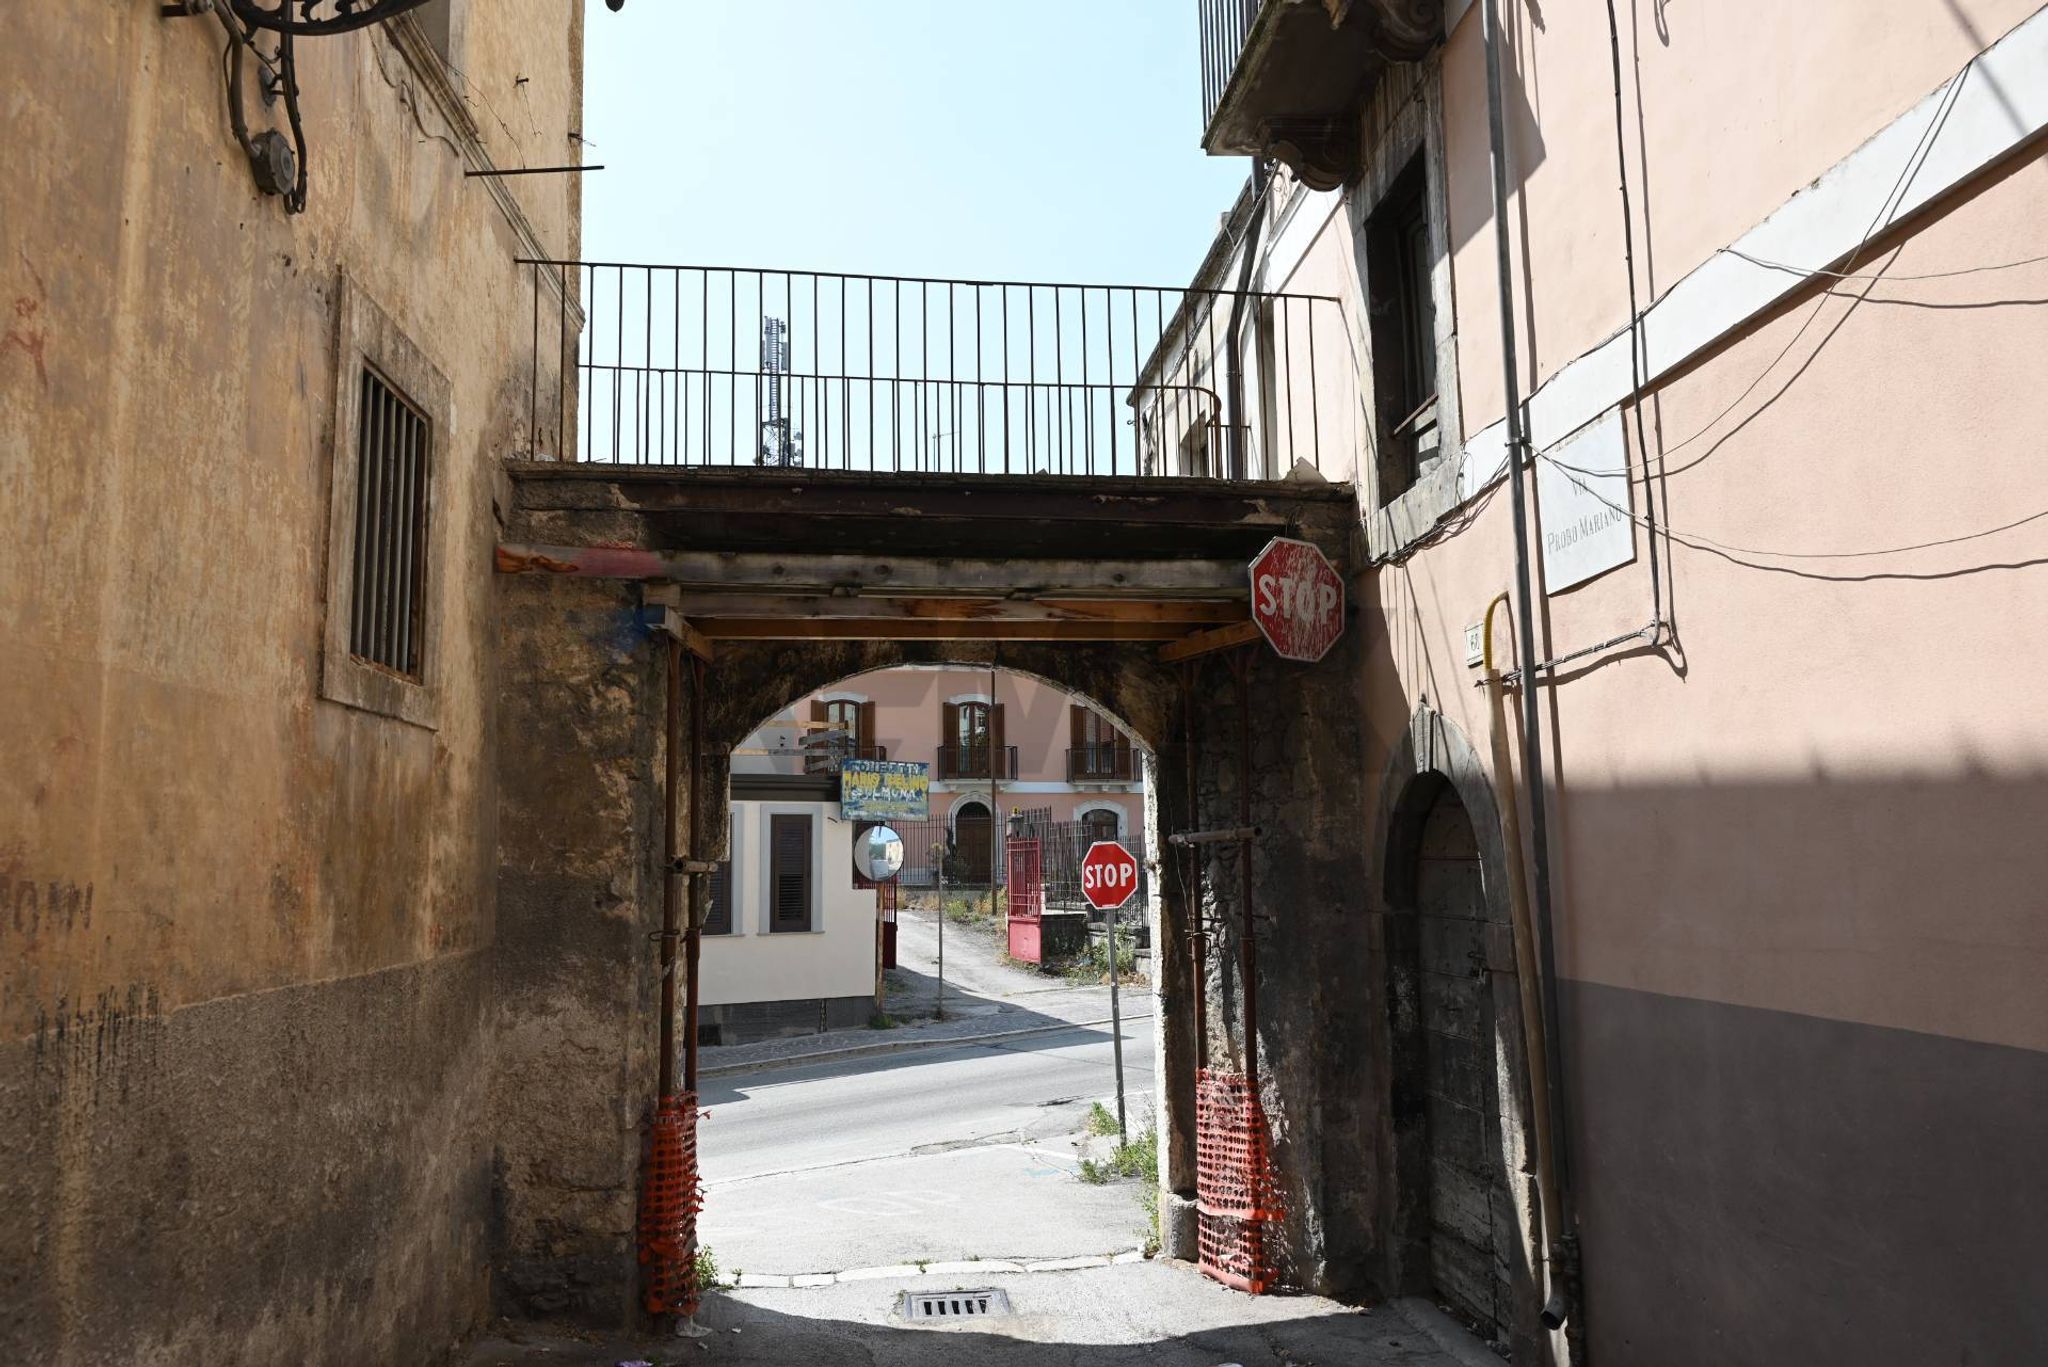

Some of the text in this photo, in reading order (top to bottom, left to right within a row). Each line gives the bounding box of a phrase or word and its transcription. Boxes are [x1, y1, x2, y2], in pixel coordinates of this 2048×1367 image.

[1547, 504, 1622, 556] PROBO MARIANO
[1259, 574, 1338, 625] STOP
[851, 786, 917, 801] SULMONA
[1085, 863, 1133, 889] STOP
